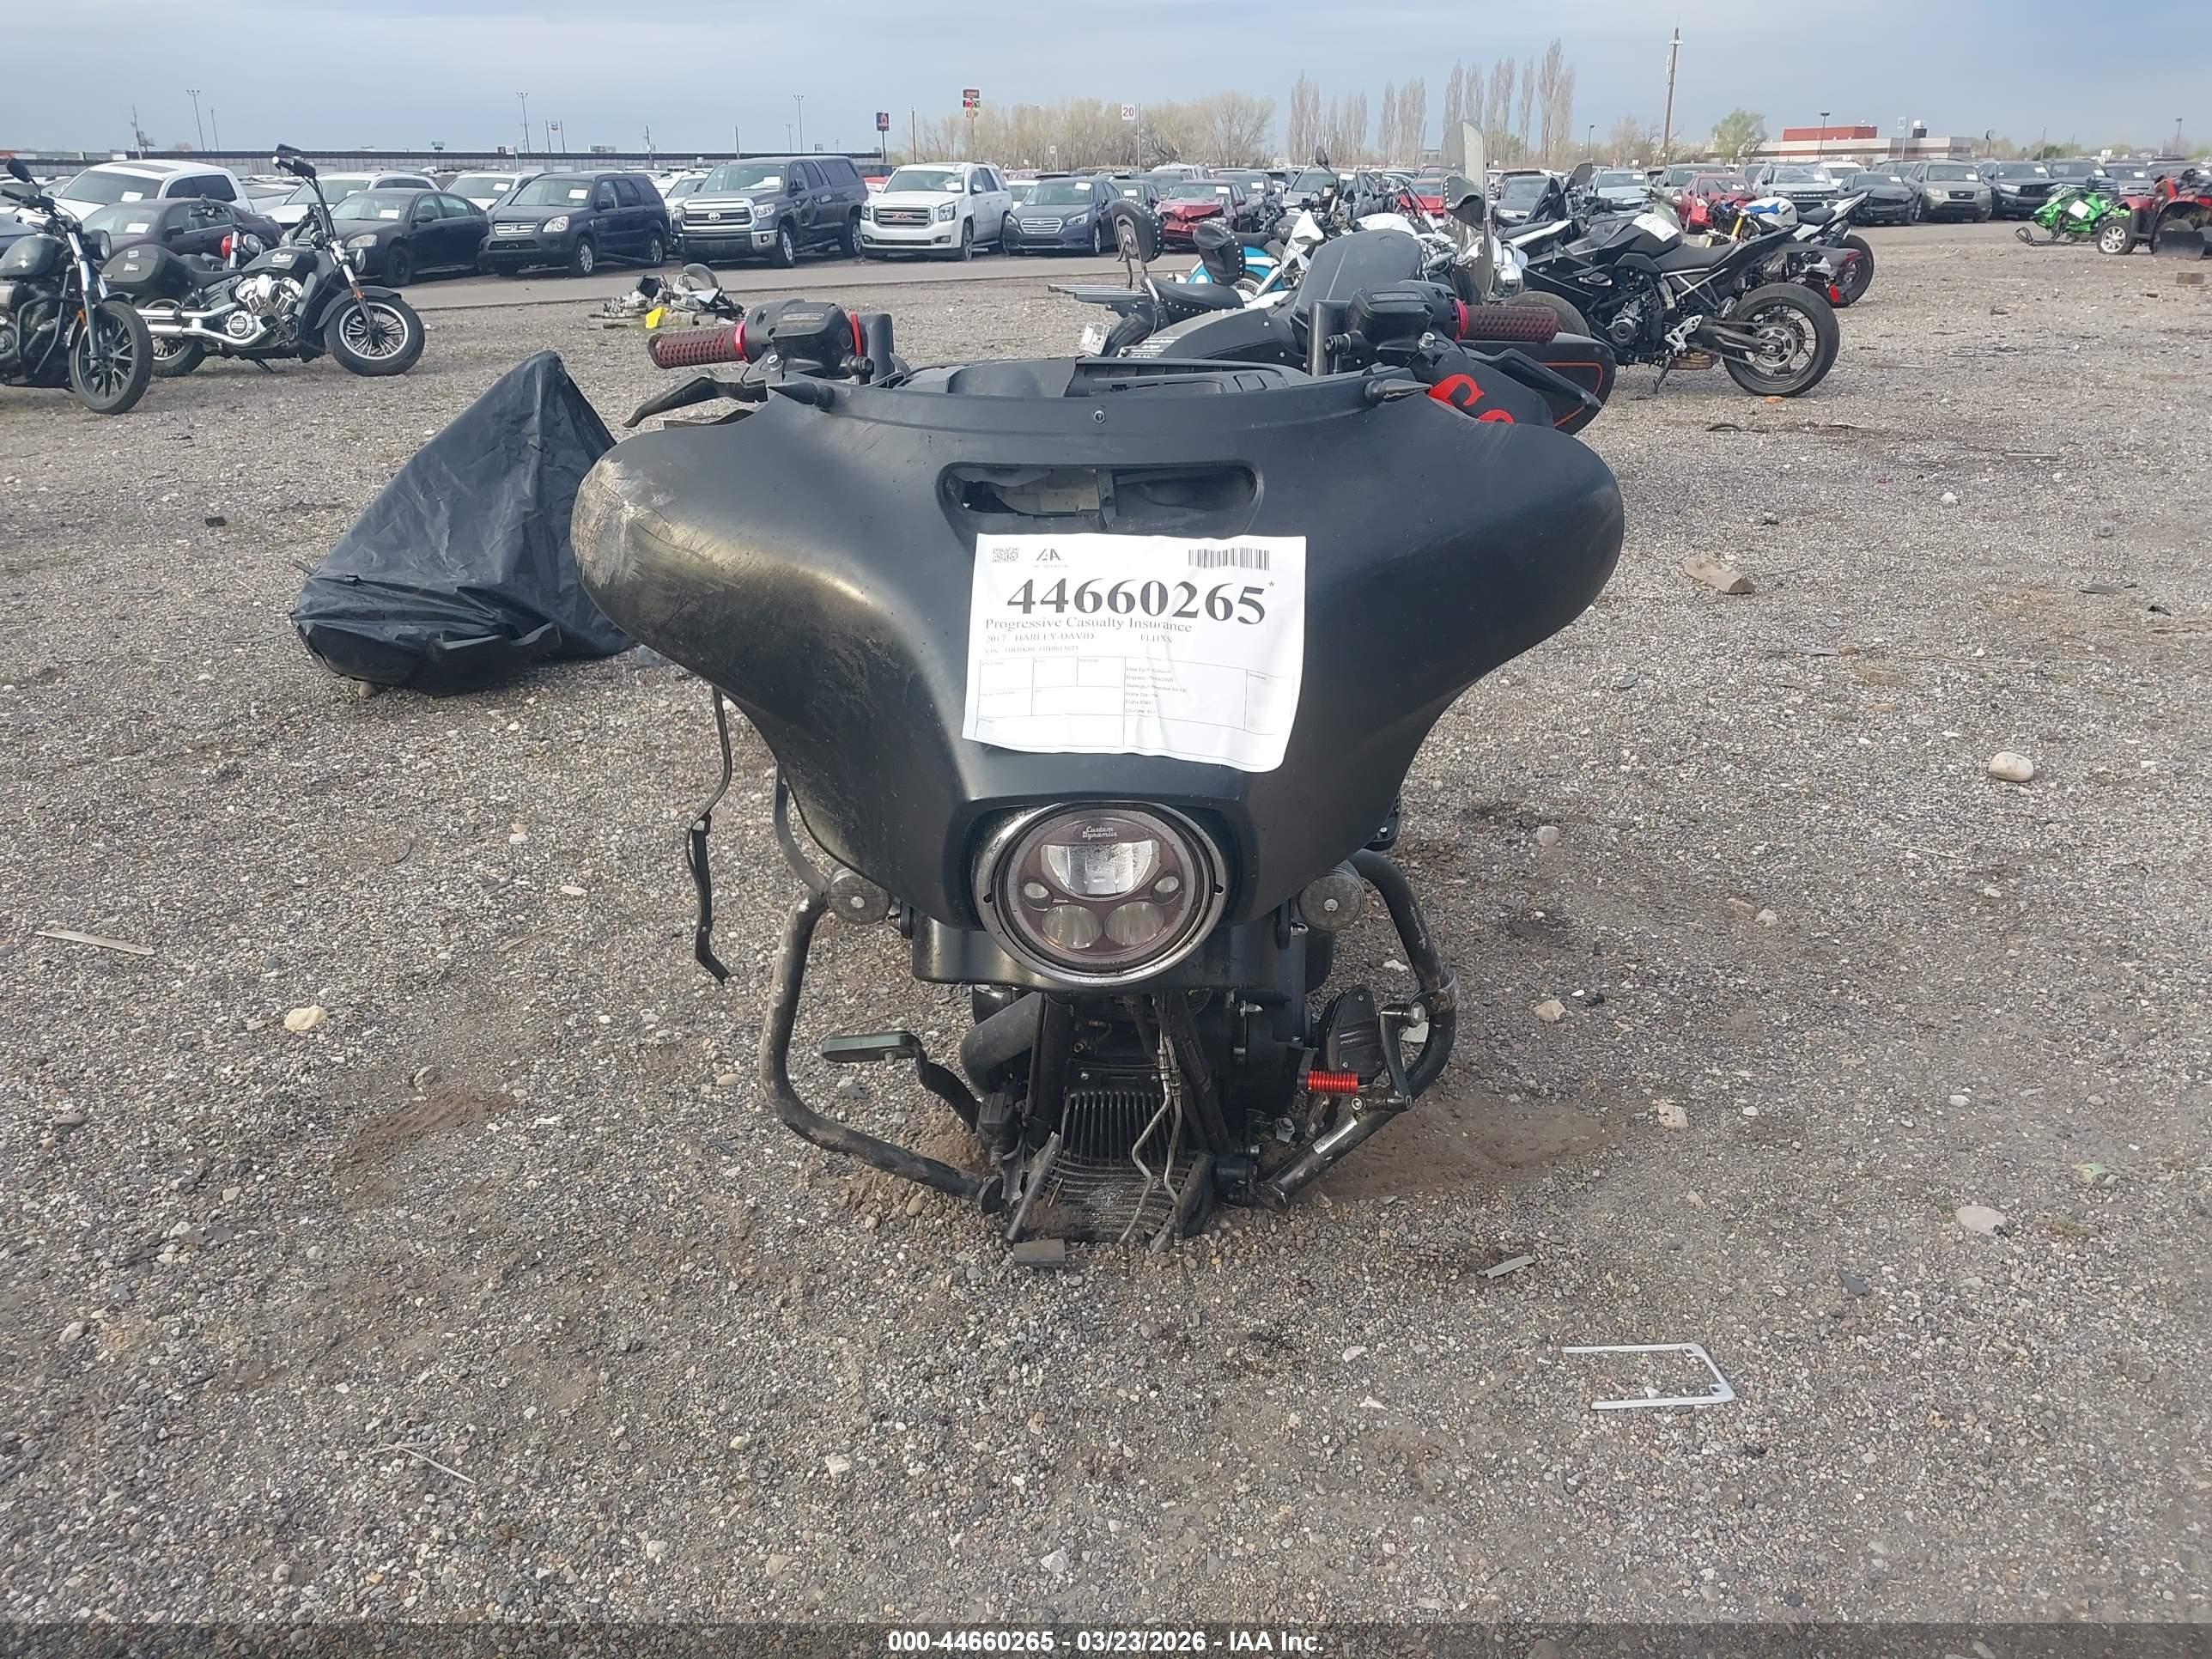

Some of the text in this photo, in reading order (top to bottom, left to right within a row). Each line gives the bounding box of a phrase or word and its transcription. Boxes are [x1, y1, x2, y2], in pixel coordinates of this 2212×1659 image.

[1122, 106, 1134, 117] 20
[1006, 577, 1266, 625] 44660265
[986, 617, 1193, 632] Progressive Casualty Insurance
[1082, 830, 1118, 840] Dynamics
